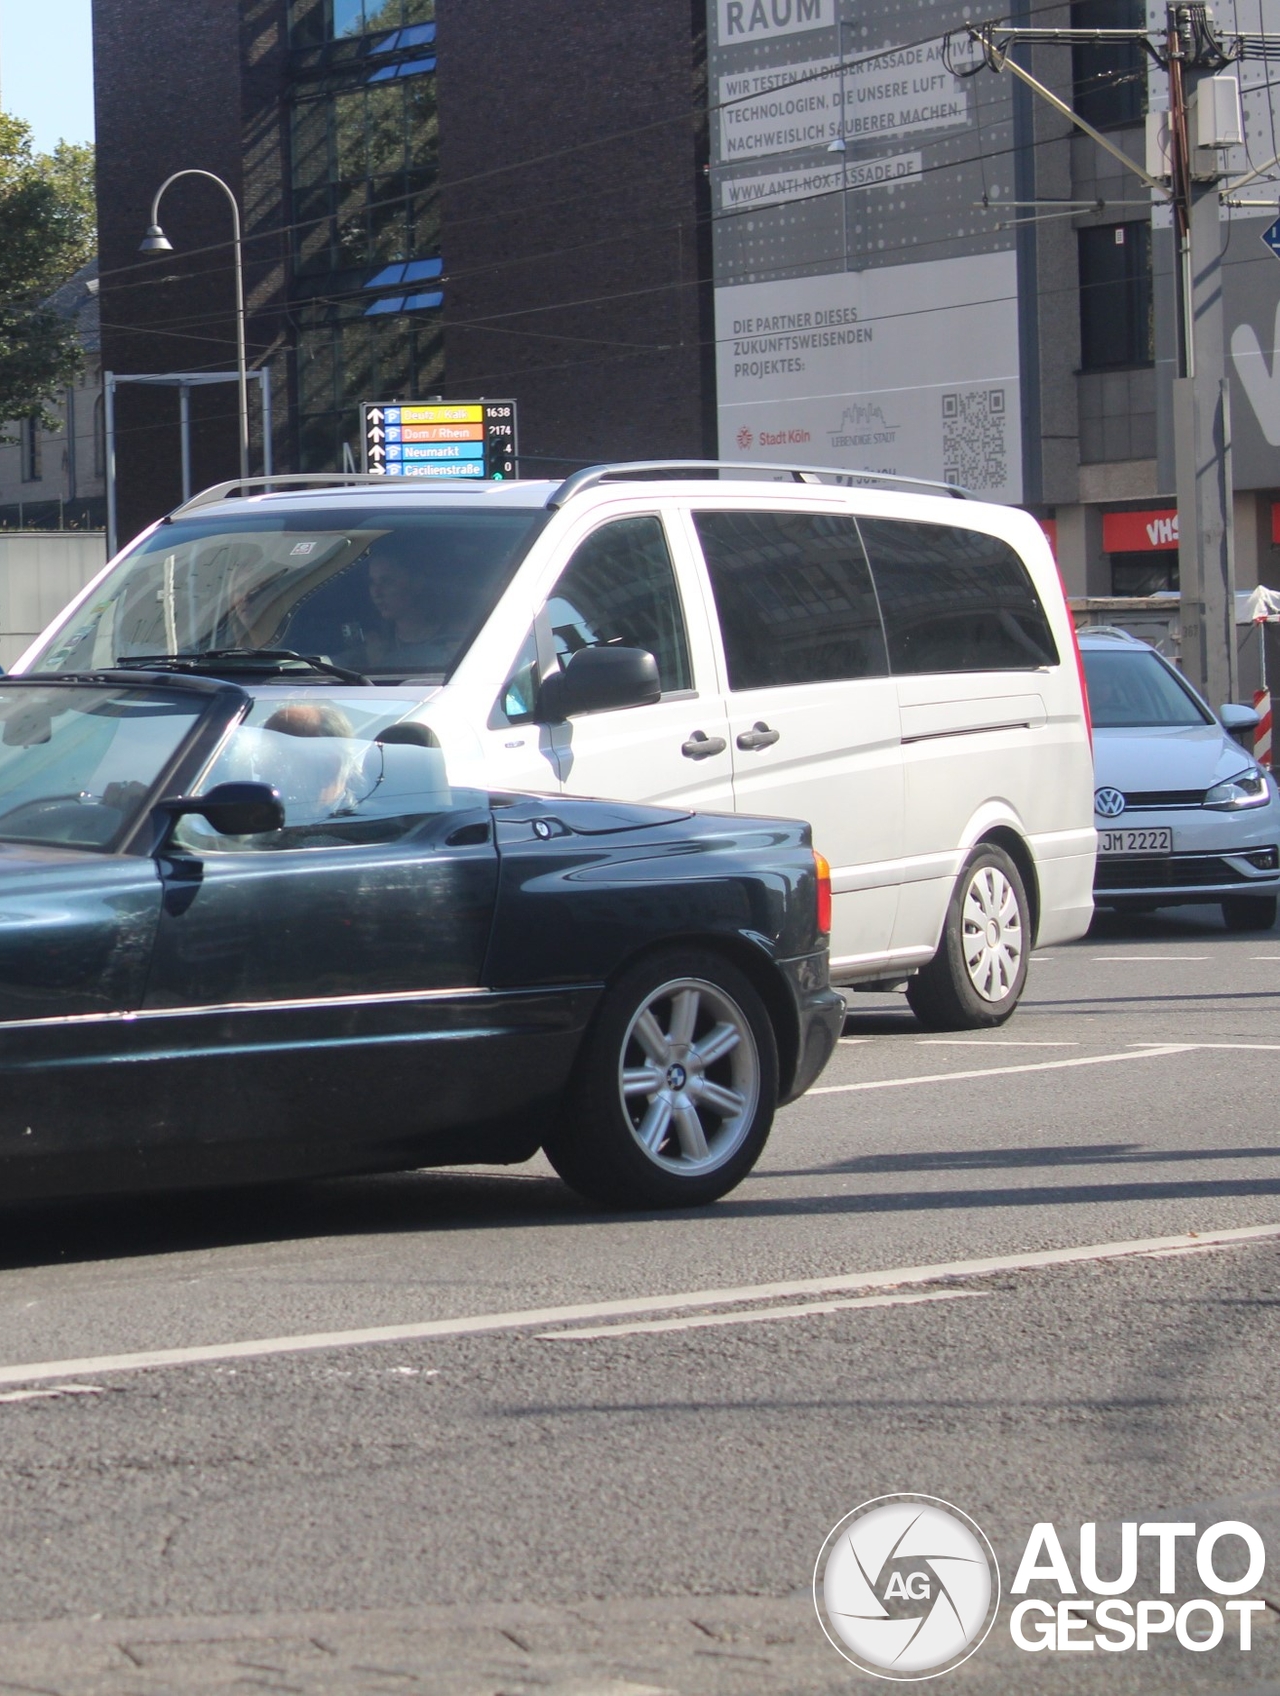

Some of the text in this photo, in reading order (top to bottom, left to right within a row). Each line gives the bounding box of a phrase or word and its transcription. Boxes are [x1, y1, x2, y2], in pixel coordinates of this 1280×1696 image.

[726, 0, 821, 36] RAUM
[726, 81, 750, 97] WIR
[752, 71, 798, 93] TESTEN
[800, 67, 819, 83] AN
[867, 48, 923, 74] FASSADE
[726, 74, 946, 125] TECHNOLOGIEN, DIE UNSERE LUFT
[727, 101, 962, 153] NACHWEISLICH SAUBERER MACHEN.
[733, 307, 858, 334] DIE PARTNER DIESES
[733, 327, 874, 357] ZUKUNFTSWEISENDEN
[734, 357, 806, 379] PROJEKTES:
[486, 407, 511, 418] 1638
[404, 428, 430, 440] Dom
[439, 426, 470, 439] Rhein
[759, 428, 811, 446] Stadt Köln
[831, 430, 897, 448] LEBENDIGE STADT
[405, 446, 460, 458] Neumarkt
[1102, 831, 1169, 851] JM 2222
